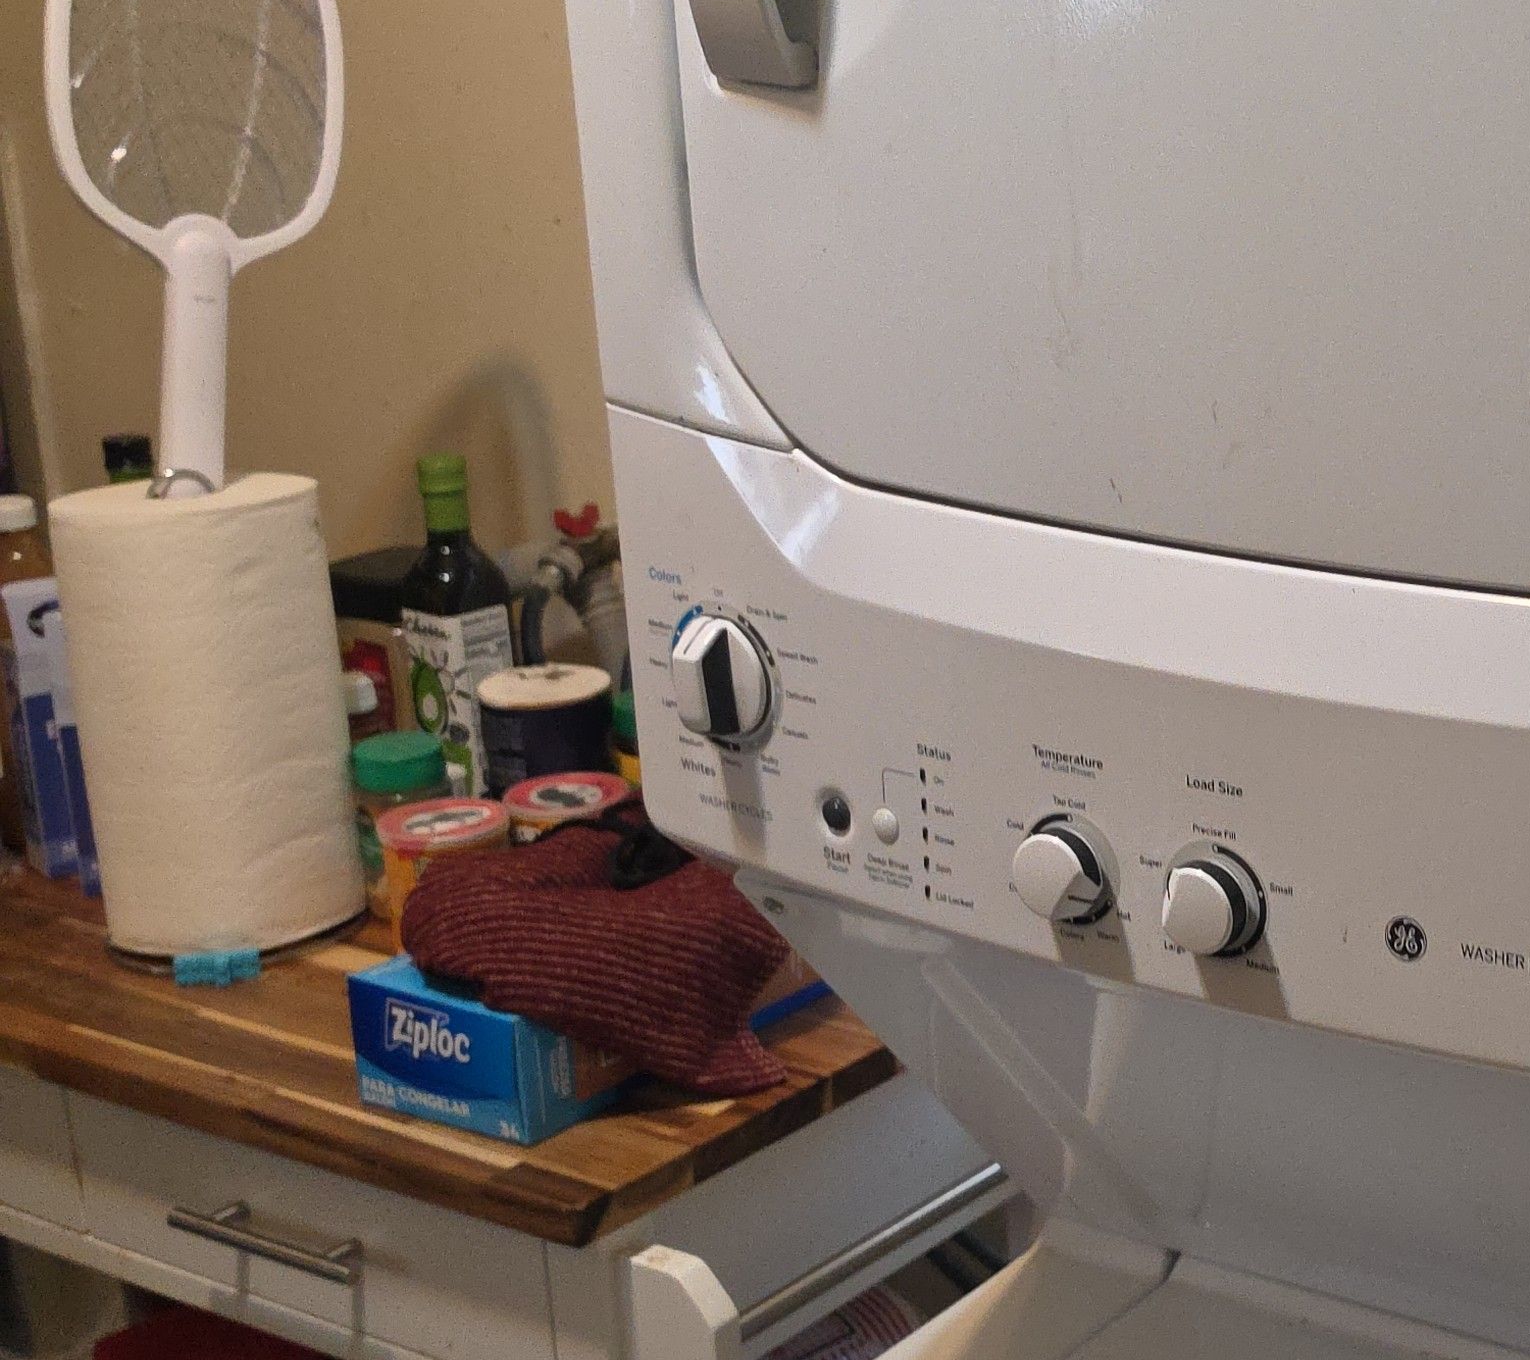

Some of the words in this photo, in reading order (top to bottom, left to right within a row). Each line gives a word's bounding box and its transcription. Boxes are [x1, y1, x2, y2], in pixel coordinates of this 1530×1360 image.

[648, 565, 682, 585] Colors
[916, 743, 951, 761] Status
[1032, 743, 1103, 770] Temperature
[681, 756, 716, 778] Whites
[1186, 774, 1215, 794] Load
[1217, 778, 1243, 797] Size
[823, 845, 851, 865] Start
[1459, 941, 1526, 971] WASHER
[390, 1006, 472, 1064] Ziploc
